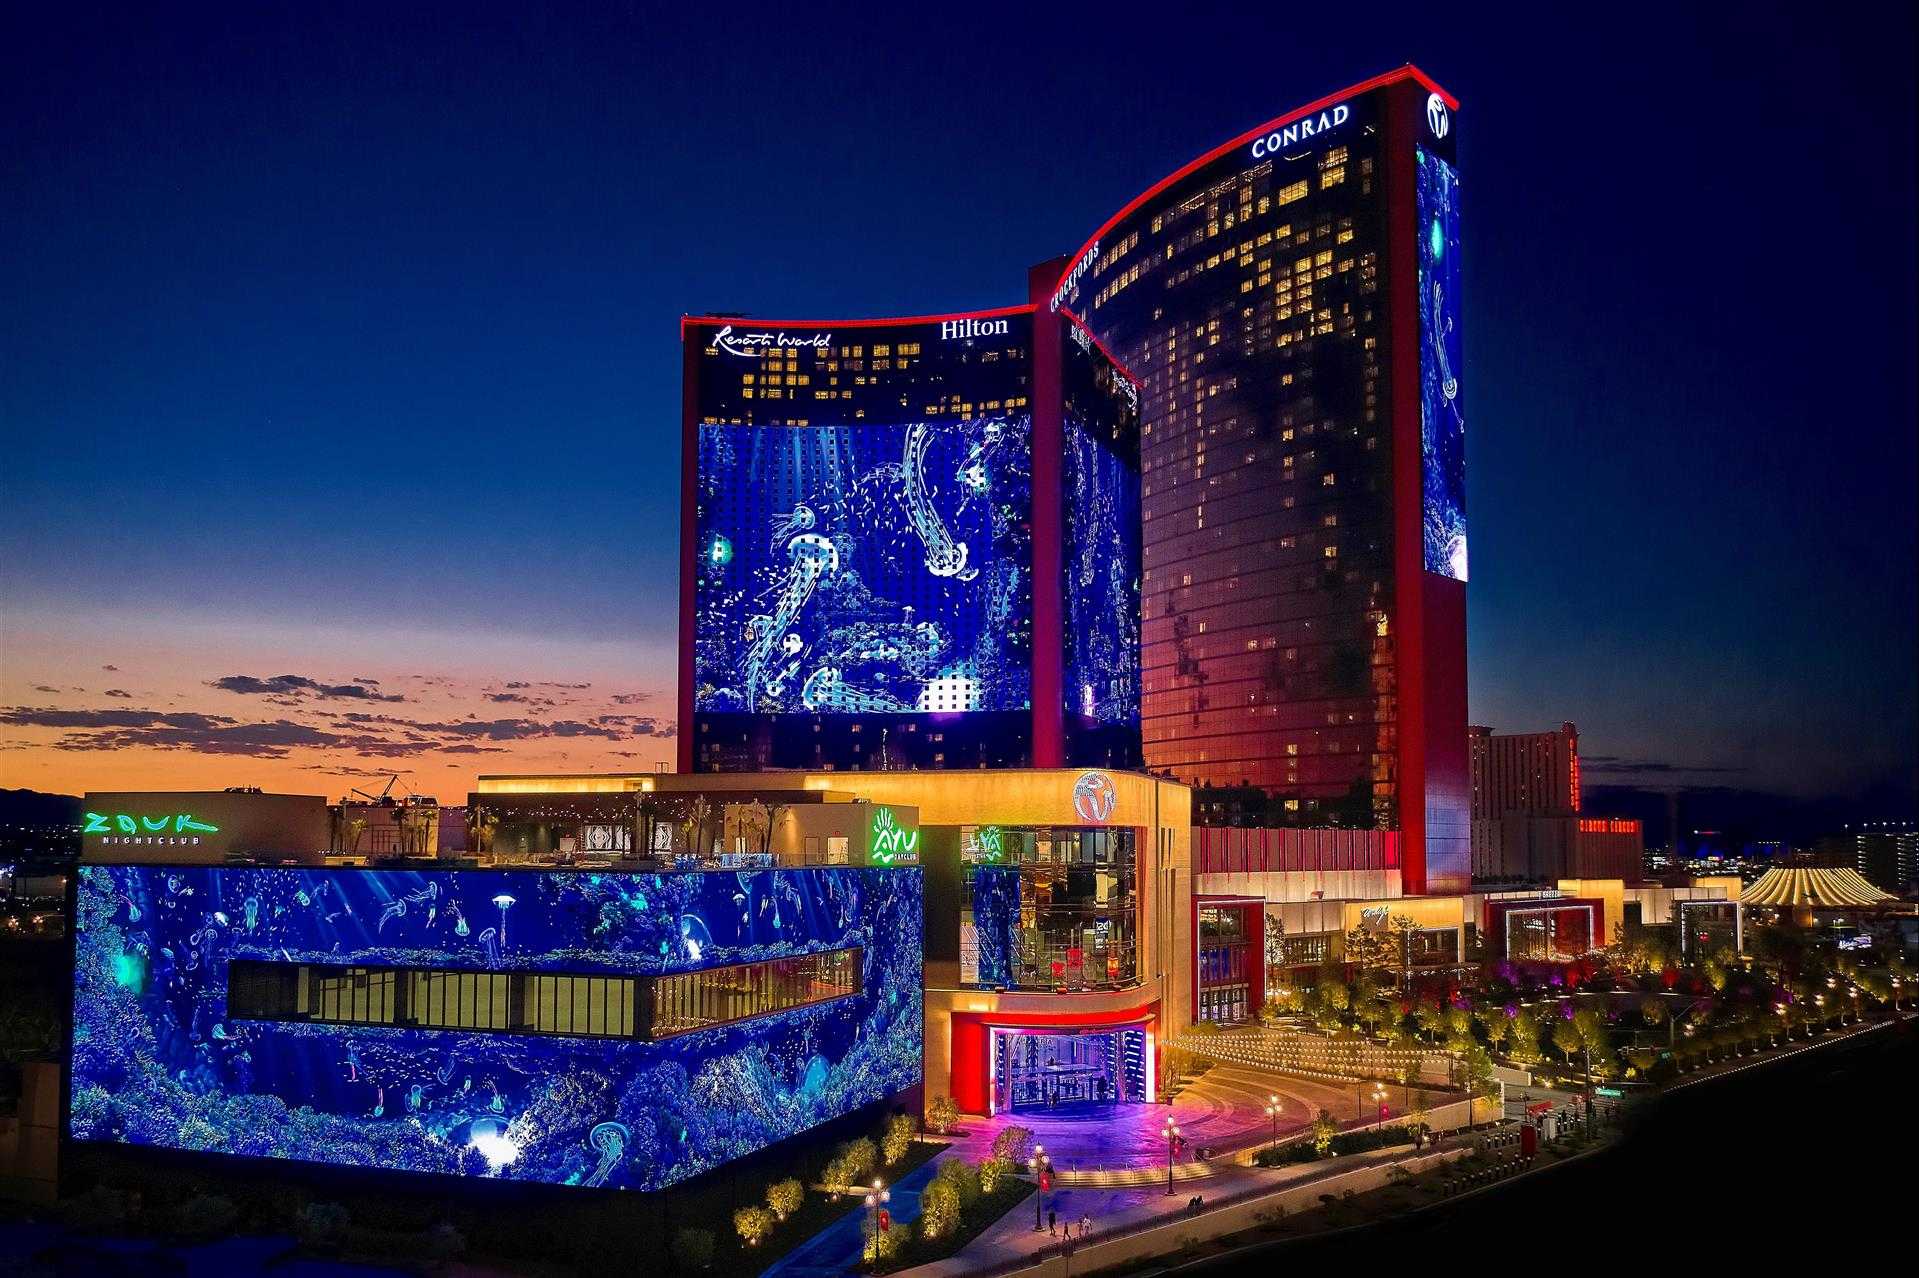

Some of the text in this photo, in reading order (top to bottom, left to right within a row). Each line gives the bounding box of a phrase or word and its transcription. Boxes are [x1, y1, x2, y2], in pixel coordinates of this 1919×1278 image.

[1252, 105, 1349, 158] CONRAD
[1050, 241, 1099, 312] CROCKFORDS
[941, 318, 1008, 340] Hilton
[84, 812, 219, 835] ZOUK
[102, 836, 200, 846] NIGHTCLUB
[873, 826, 917, 851] AYU
